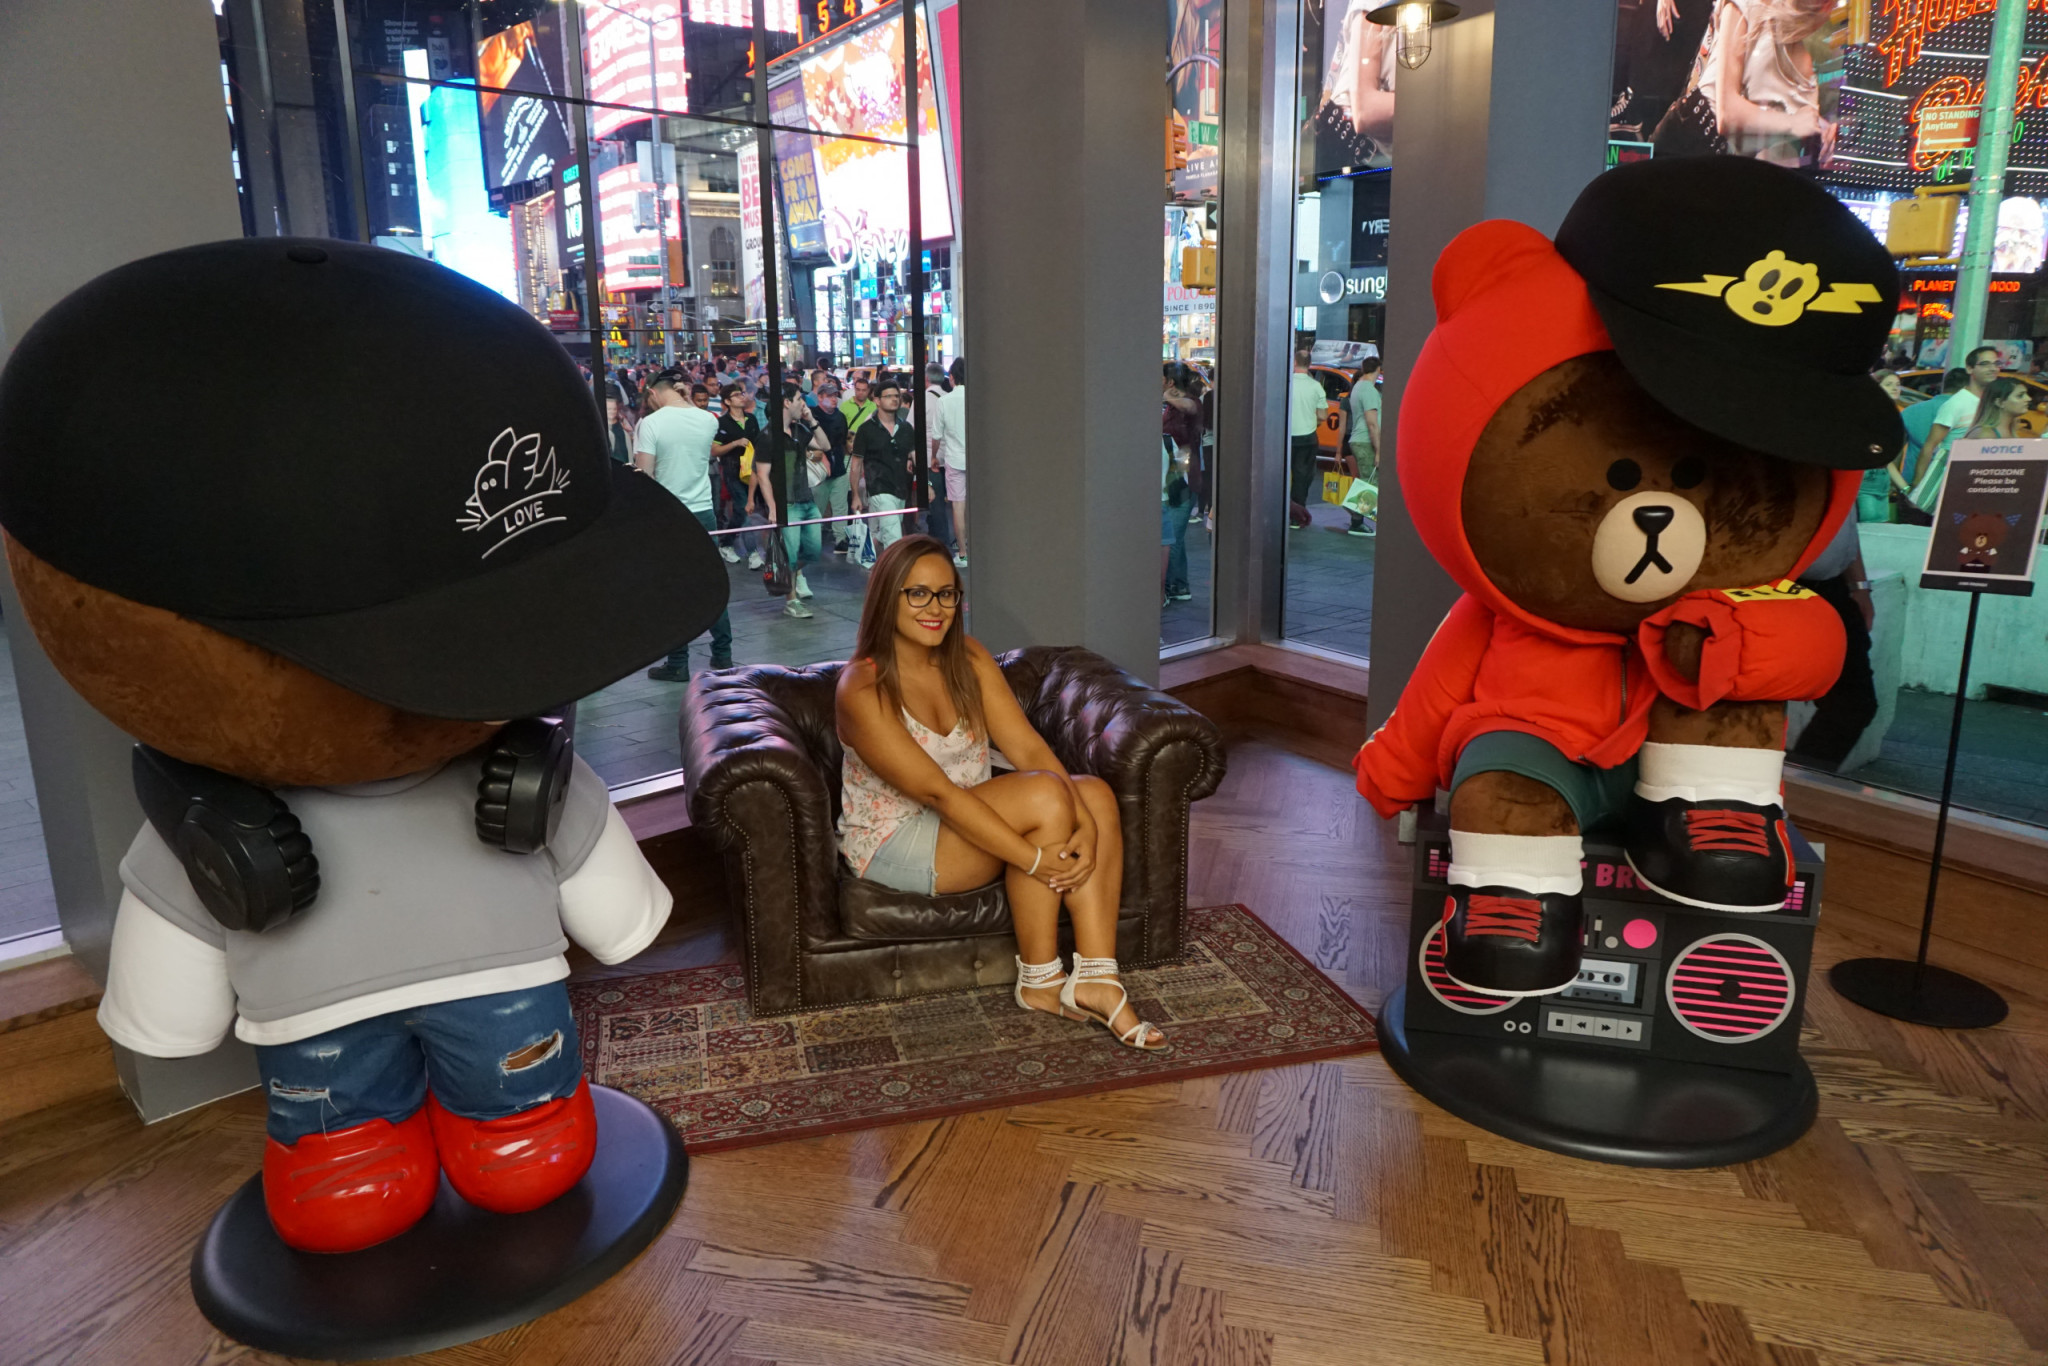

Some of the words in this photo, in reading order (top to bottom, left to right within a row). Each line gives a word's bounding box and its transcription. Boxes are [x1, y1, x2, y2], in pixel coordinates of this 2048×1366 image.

[588, 3, 679, 70] EXPRESS
[1925, 112, 1938, 120] NO
[1939, 109, 1980, 120] STANDING
[1924, 122, 1959, 131] Anytime
[1201, 125, 1210, 143] W
[781, 152, 813, 182] COME
[1186, 160, 1206, 173] LIVE
[788, 197, 818, 226] AWAY
[1913, 280, 1956, 292] PLANET
[1167, 286, 1200, 301] POLO
[1164, 304, 1190, 312] SINCE
[1193, 302, 1216, 310] 1890
[1980, 445, 2025, 454] NOTICE
[1968, 468, 2026, 476] PHOTOZONE
[1974, 477, 2003, 485] Please
[2004, 477, 2017, 485] be
[1967, 486, 2020, 494] considerate
[503, 501, 545, 533] LOVE
